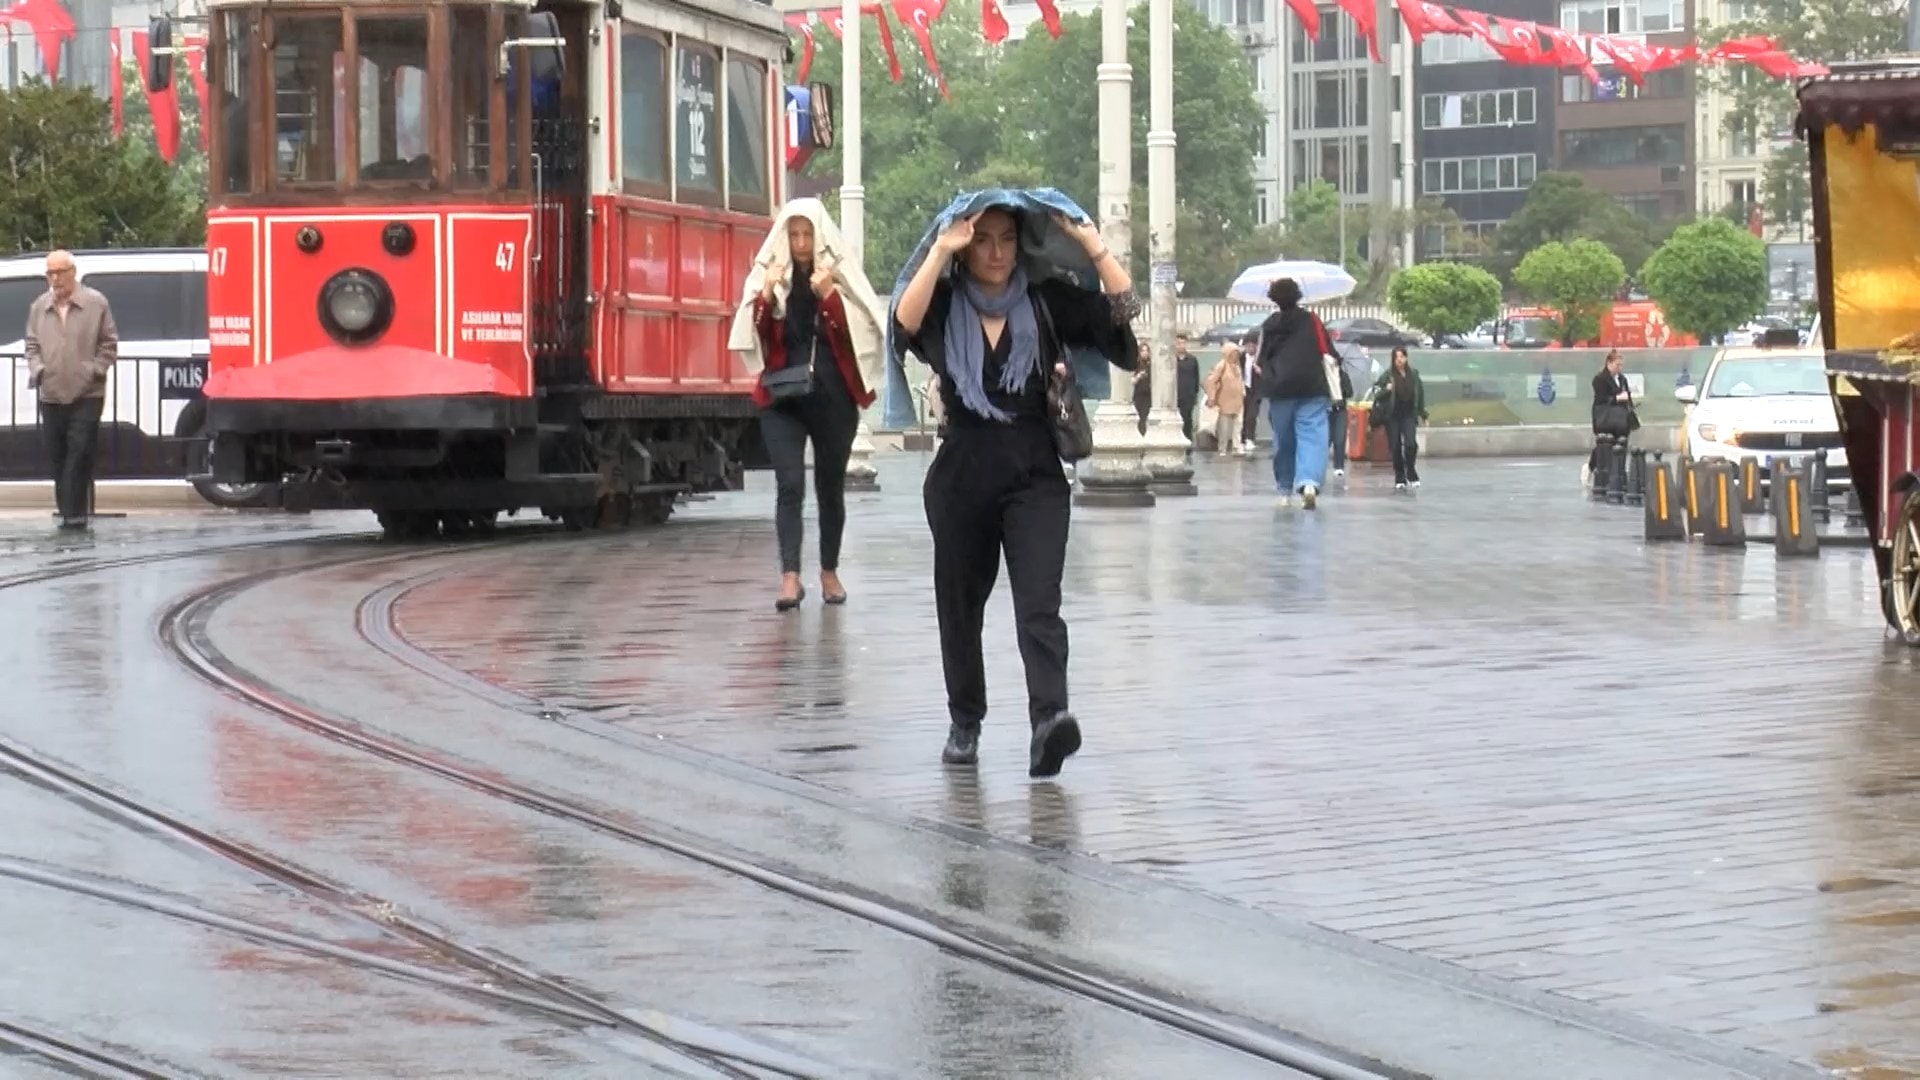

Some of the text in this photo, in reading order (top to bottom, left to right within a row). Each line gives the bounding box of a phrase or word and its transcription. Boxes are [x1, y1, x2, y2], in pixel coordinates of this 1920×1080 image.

[689, 110, 705, 156] 112
[495, 242, 515, 272] 47
[164, 363, 203, 389] POLİS
